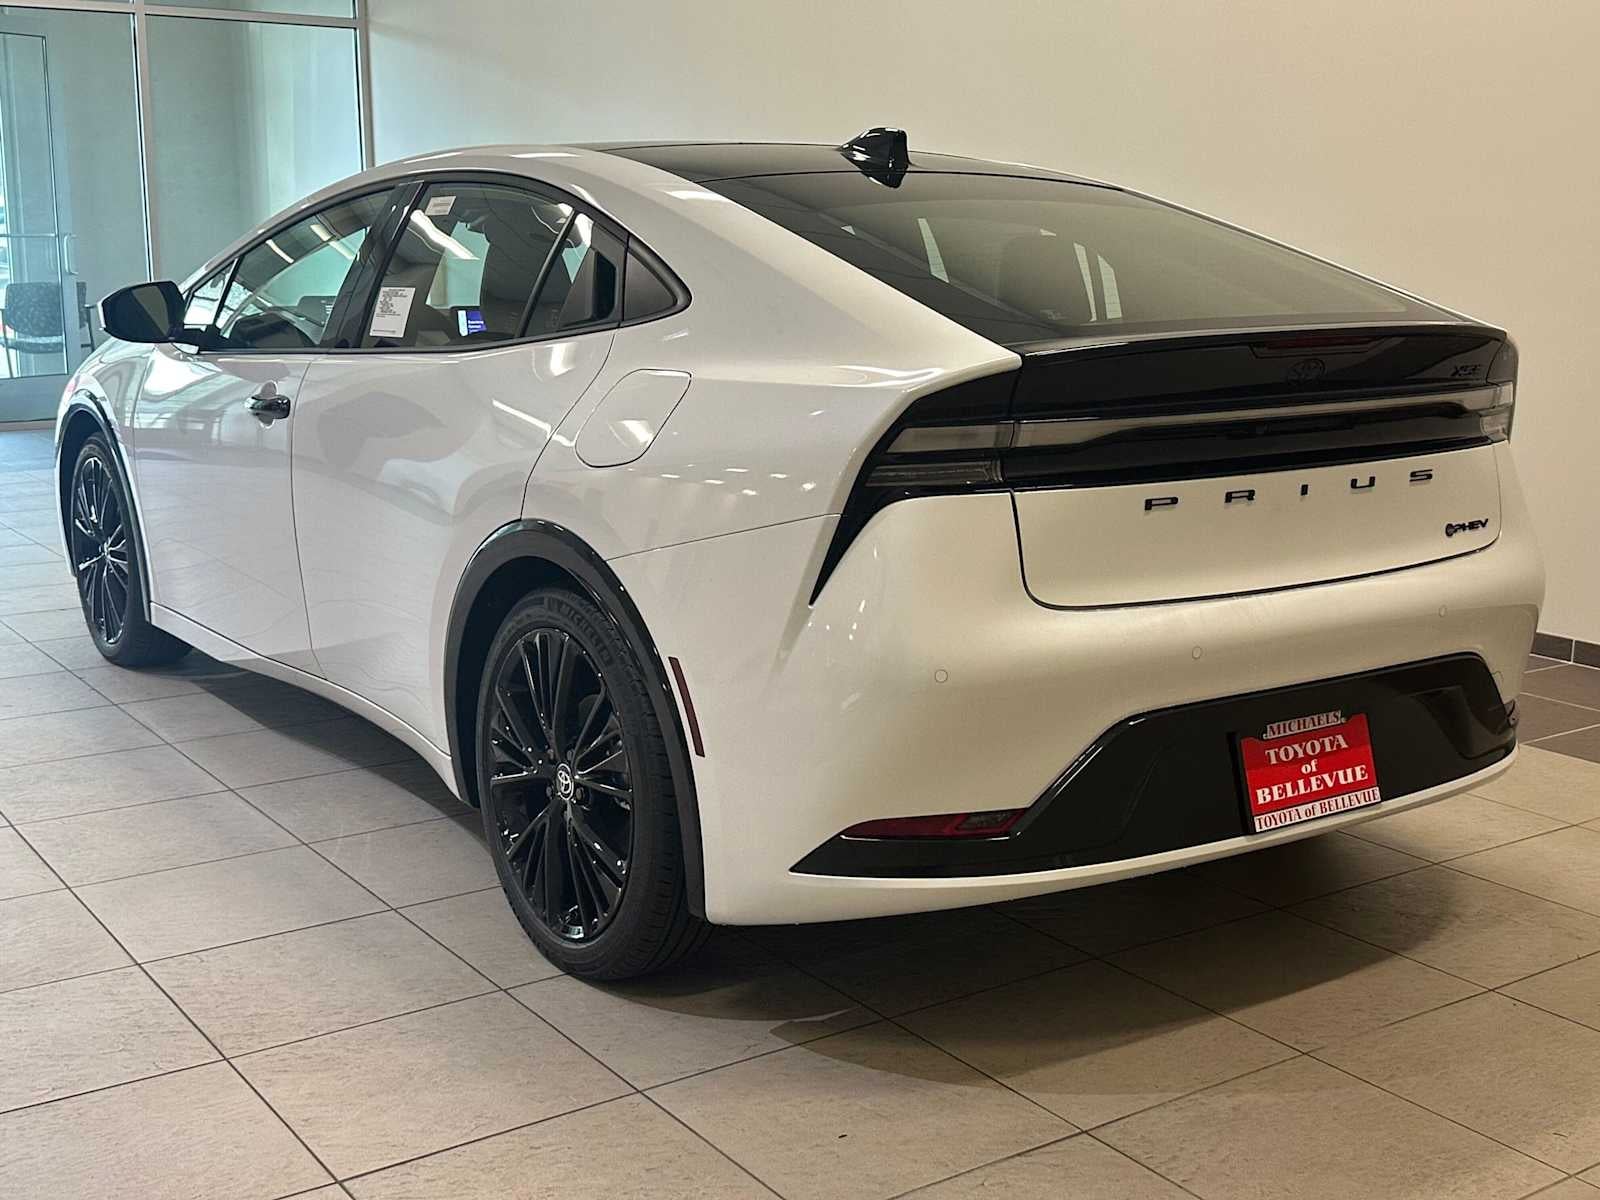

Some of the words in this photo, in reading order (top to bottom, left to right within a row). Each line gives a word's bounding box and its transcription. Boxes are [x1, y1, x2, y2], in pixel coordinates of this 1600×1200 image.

[1144, 469, 1433, 511] PRIUS
[1453, 518, 1489, 533] PHEV
[1267, 711, 1341, 737] MICHAELS
[1265, 735, 1348, 764] TOYOTA
[1301, 759, 1318, 775] of
[1256, 764, 1368, 804] BELLEVUE
[1257, 812, 1302, 829] TOYOTA
[1304, 804, 1317, 818] of
[1320, 788, 1379, 812] BELLEVUE
